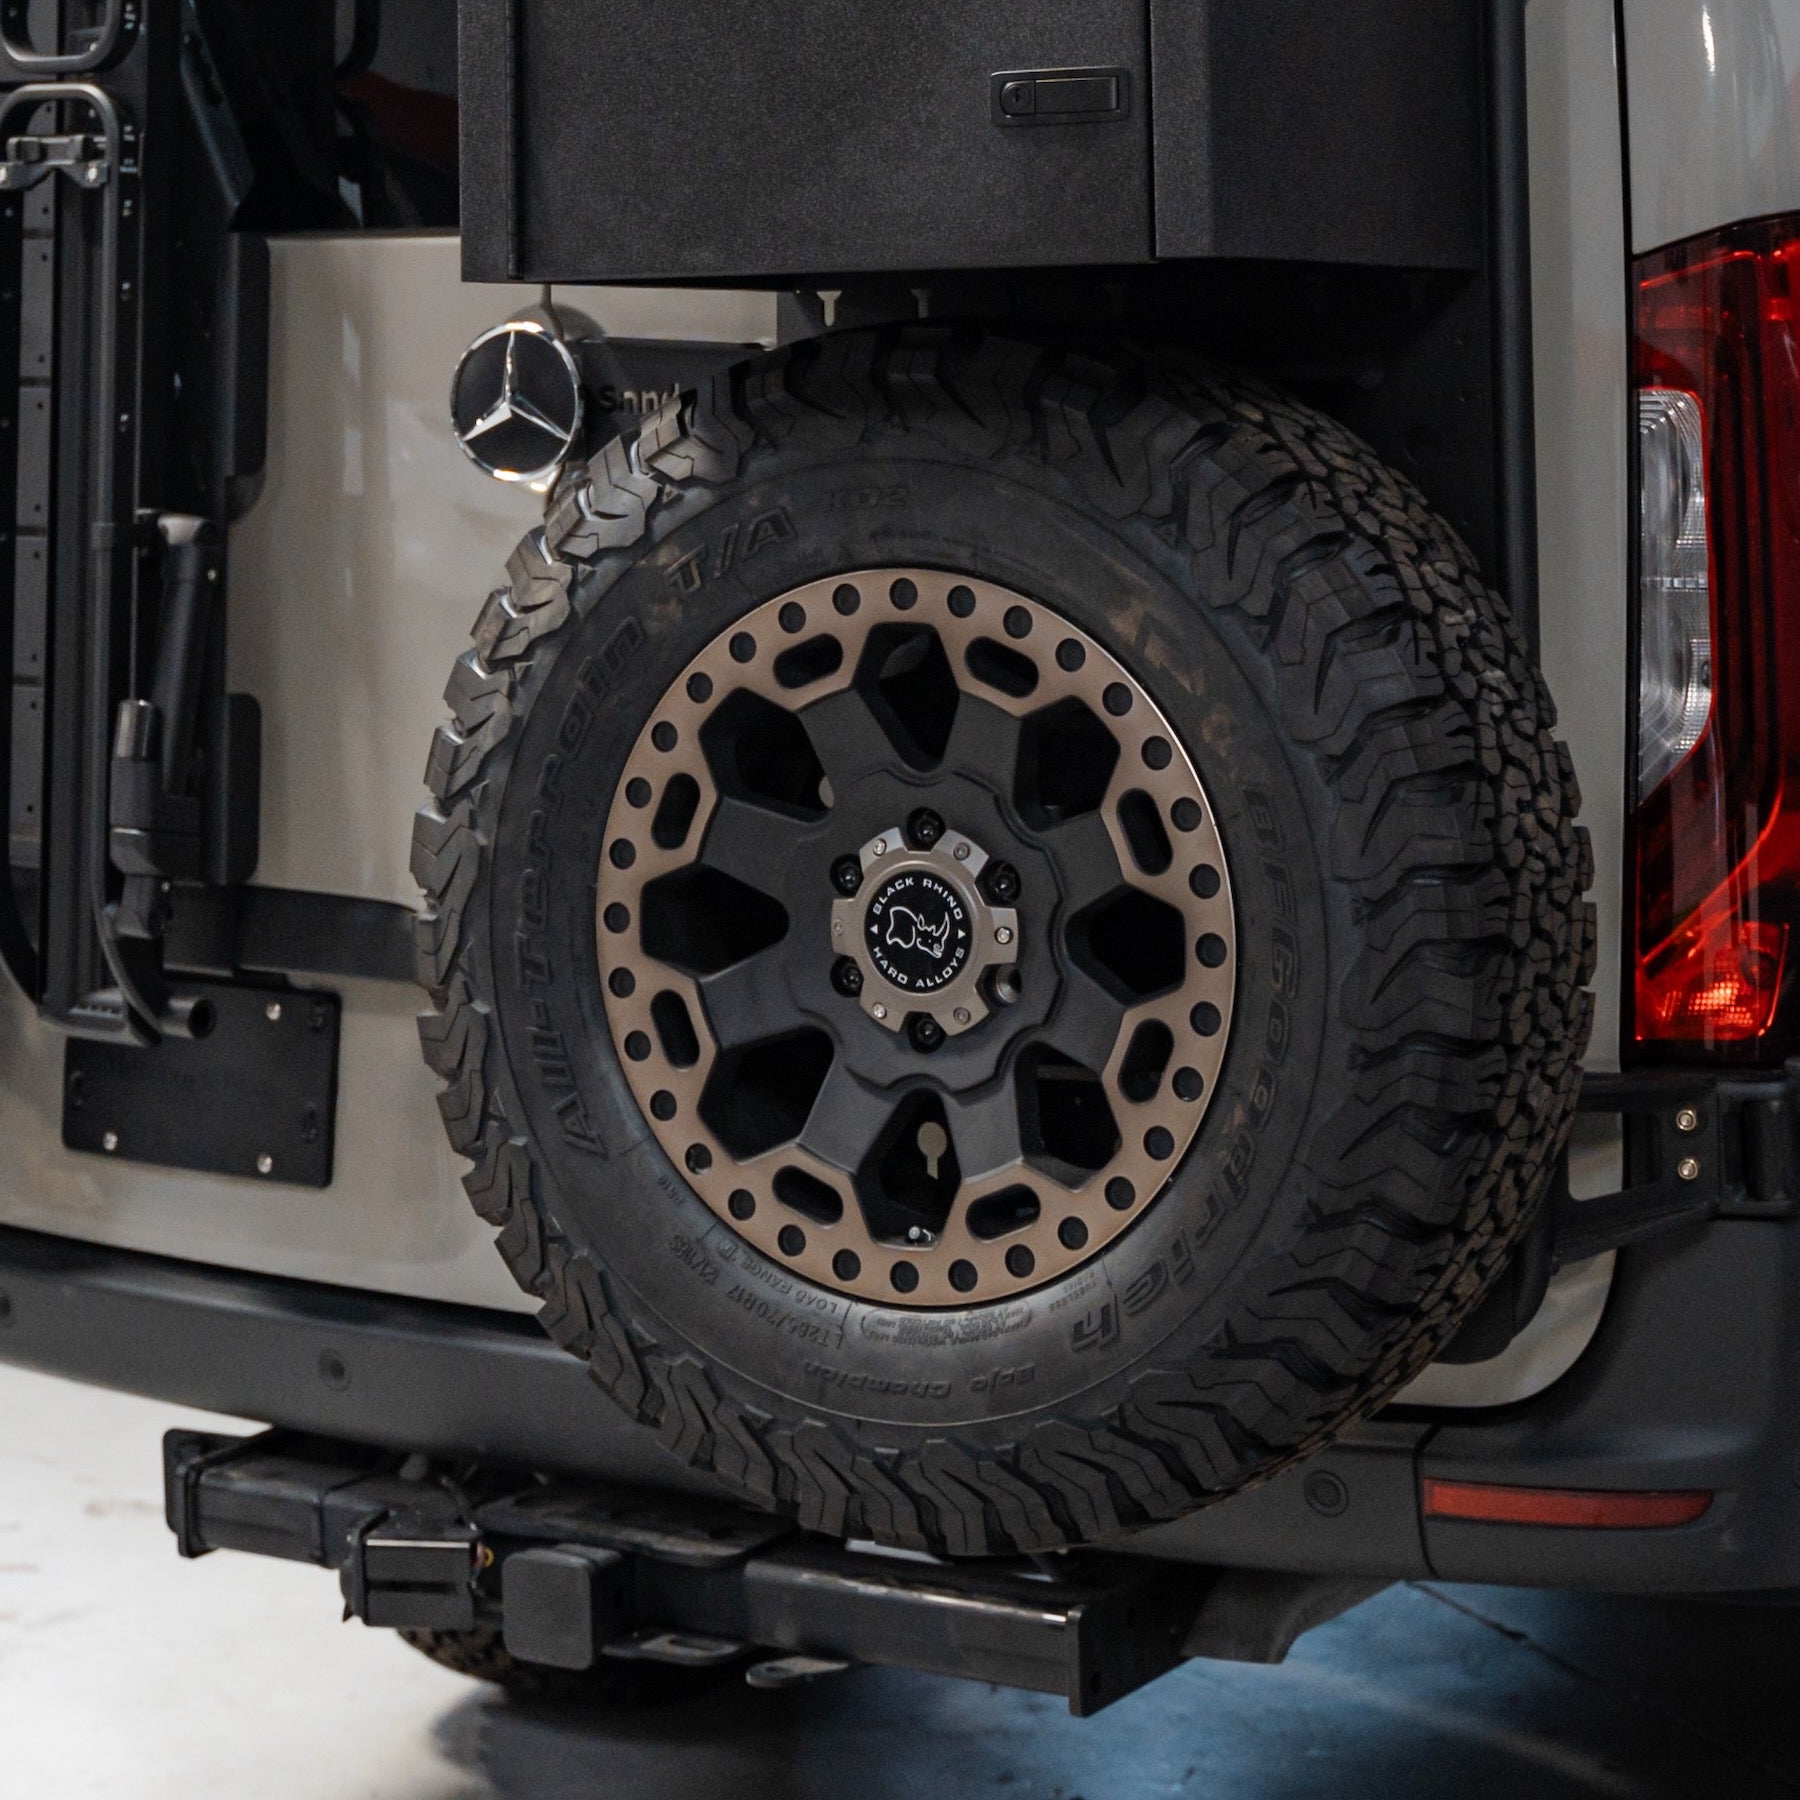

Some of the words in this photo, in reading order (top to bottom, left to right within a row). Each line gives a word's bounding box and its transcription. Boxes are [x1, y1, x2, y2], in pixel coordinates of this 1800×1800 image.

[514, 614, 646, 1160] All-Terrain
[664, 505, 799, 596] T/A
[873, 877, 914, 915] BLACK
[923, 878, 963, 920] RHINO
[873, 947, 908, 985] HARD
[915, 947, 965, 988] ALLOYS
[1070, 785, 1299, 1353] BFGoodrich
[803, 1361, 951, 1400] Champion
